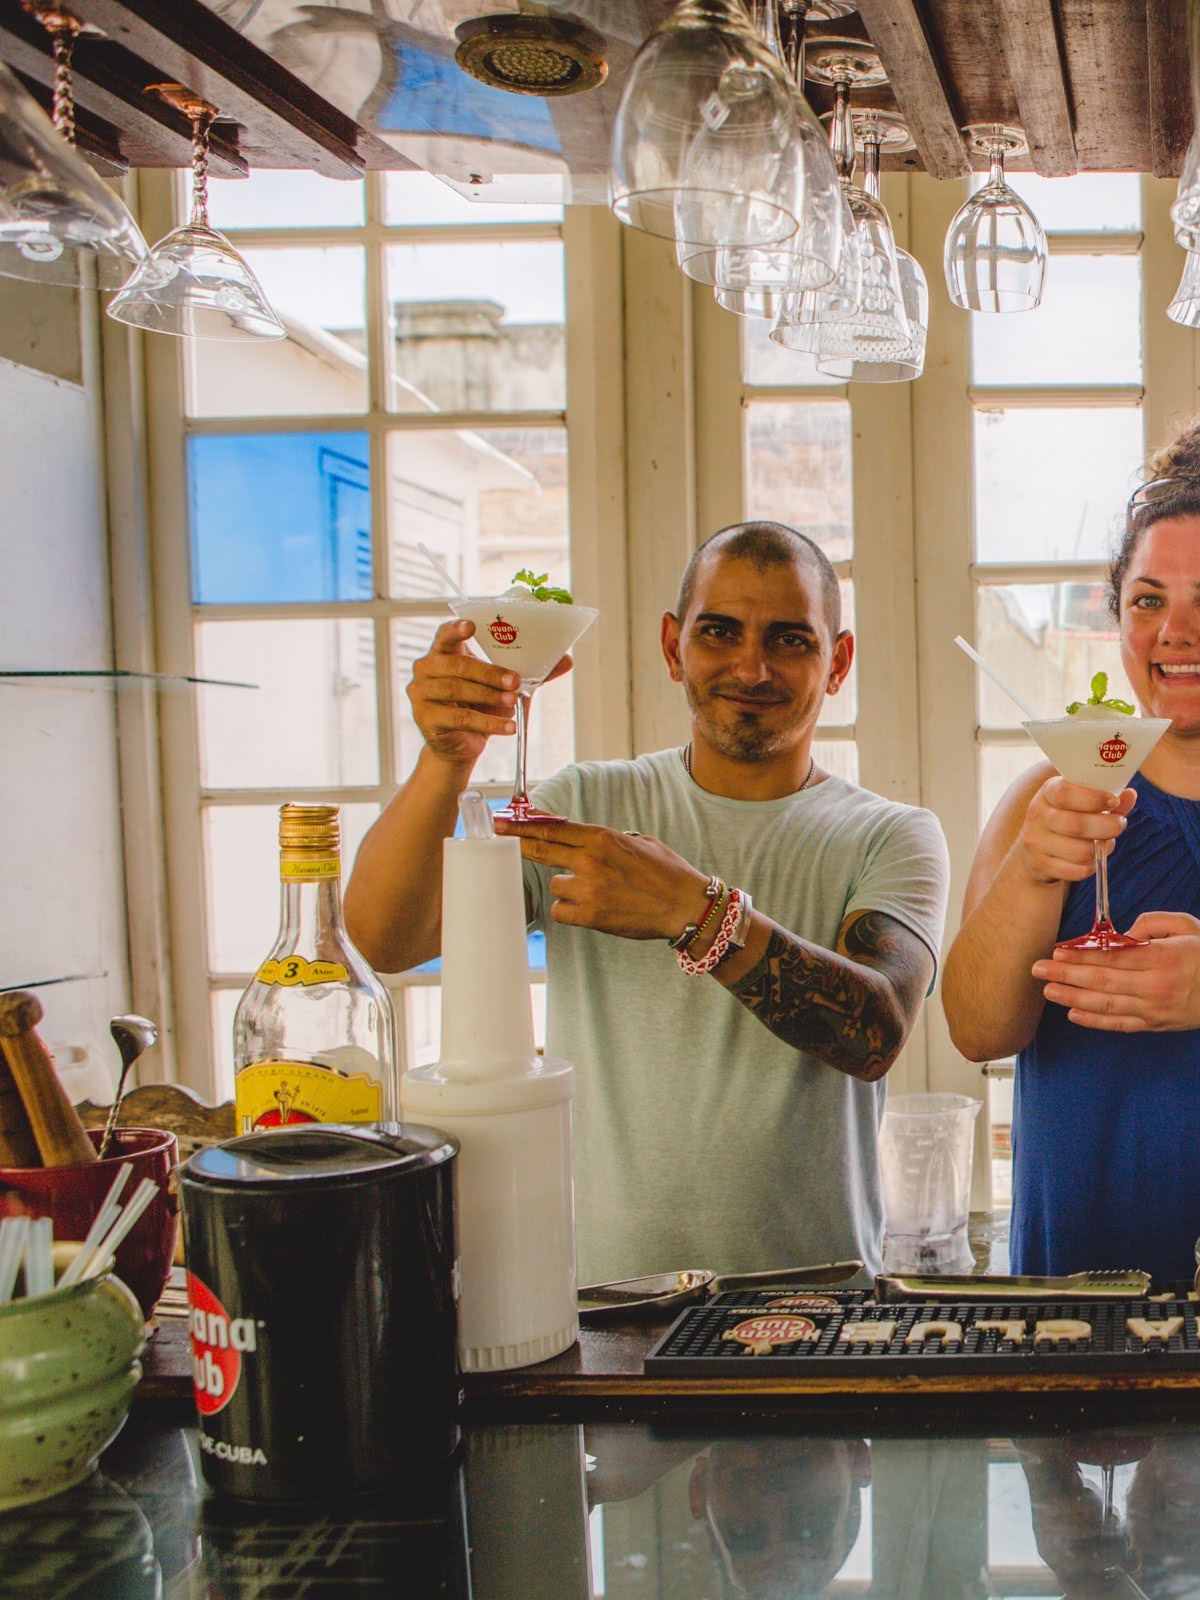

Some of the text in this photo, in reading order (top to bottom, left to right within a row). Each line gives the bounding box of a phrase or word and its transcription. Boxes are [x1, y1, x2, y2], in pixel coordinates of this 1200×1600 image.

[494, 632, 514, 641] Club
[1102, 750, 1123, 760] Club
[284, 962, 299, 978] 3
[751, 1319, 806, 1331] Club
[722, 1328, 822, 1343] Havana
[214, 1441, 268, 1467] CUBA
